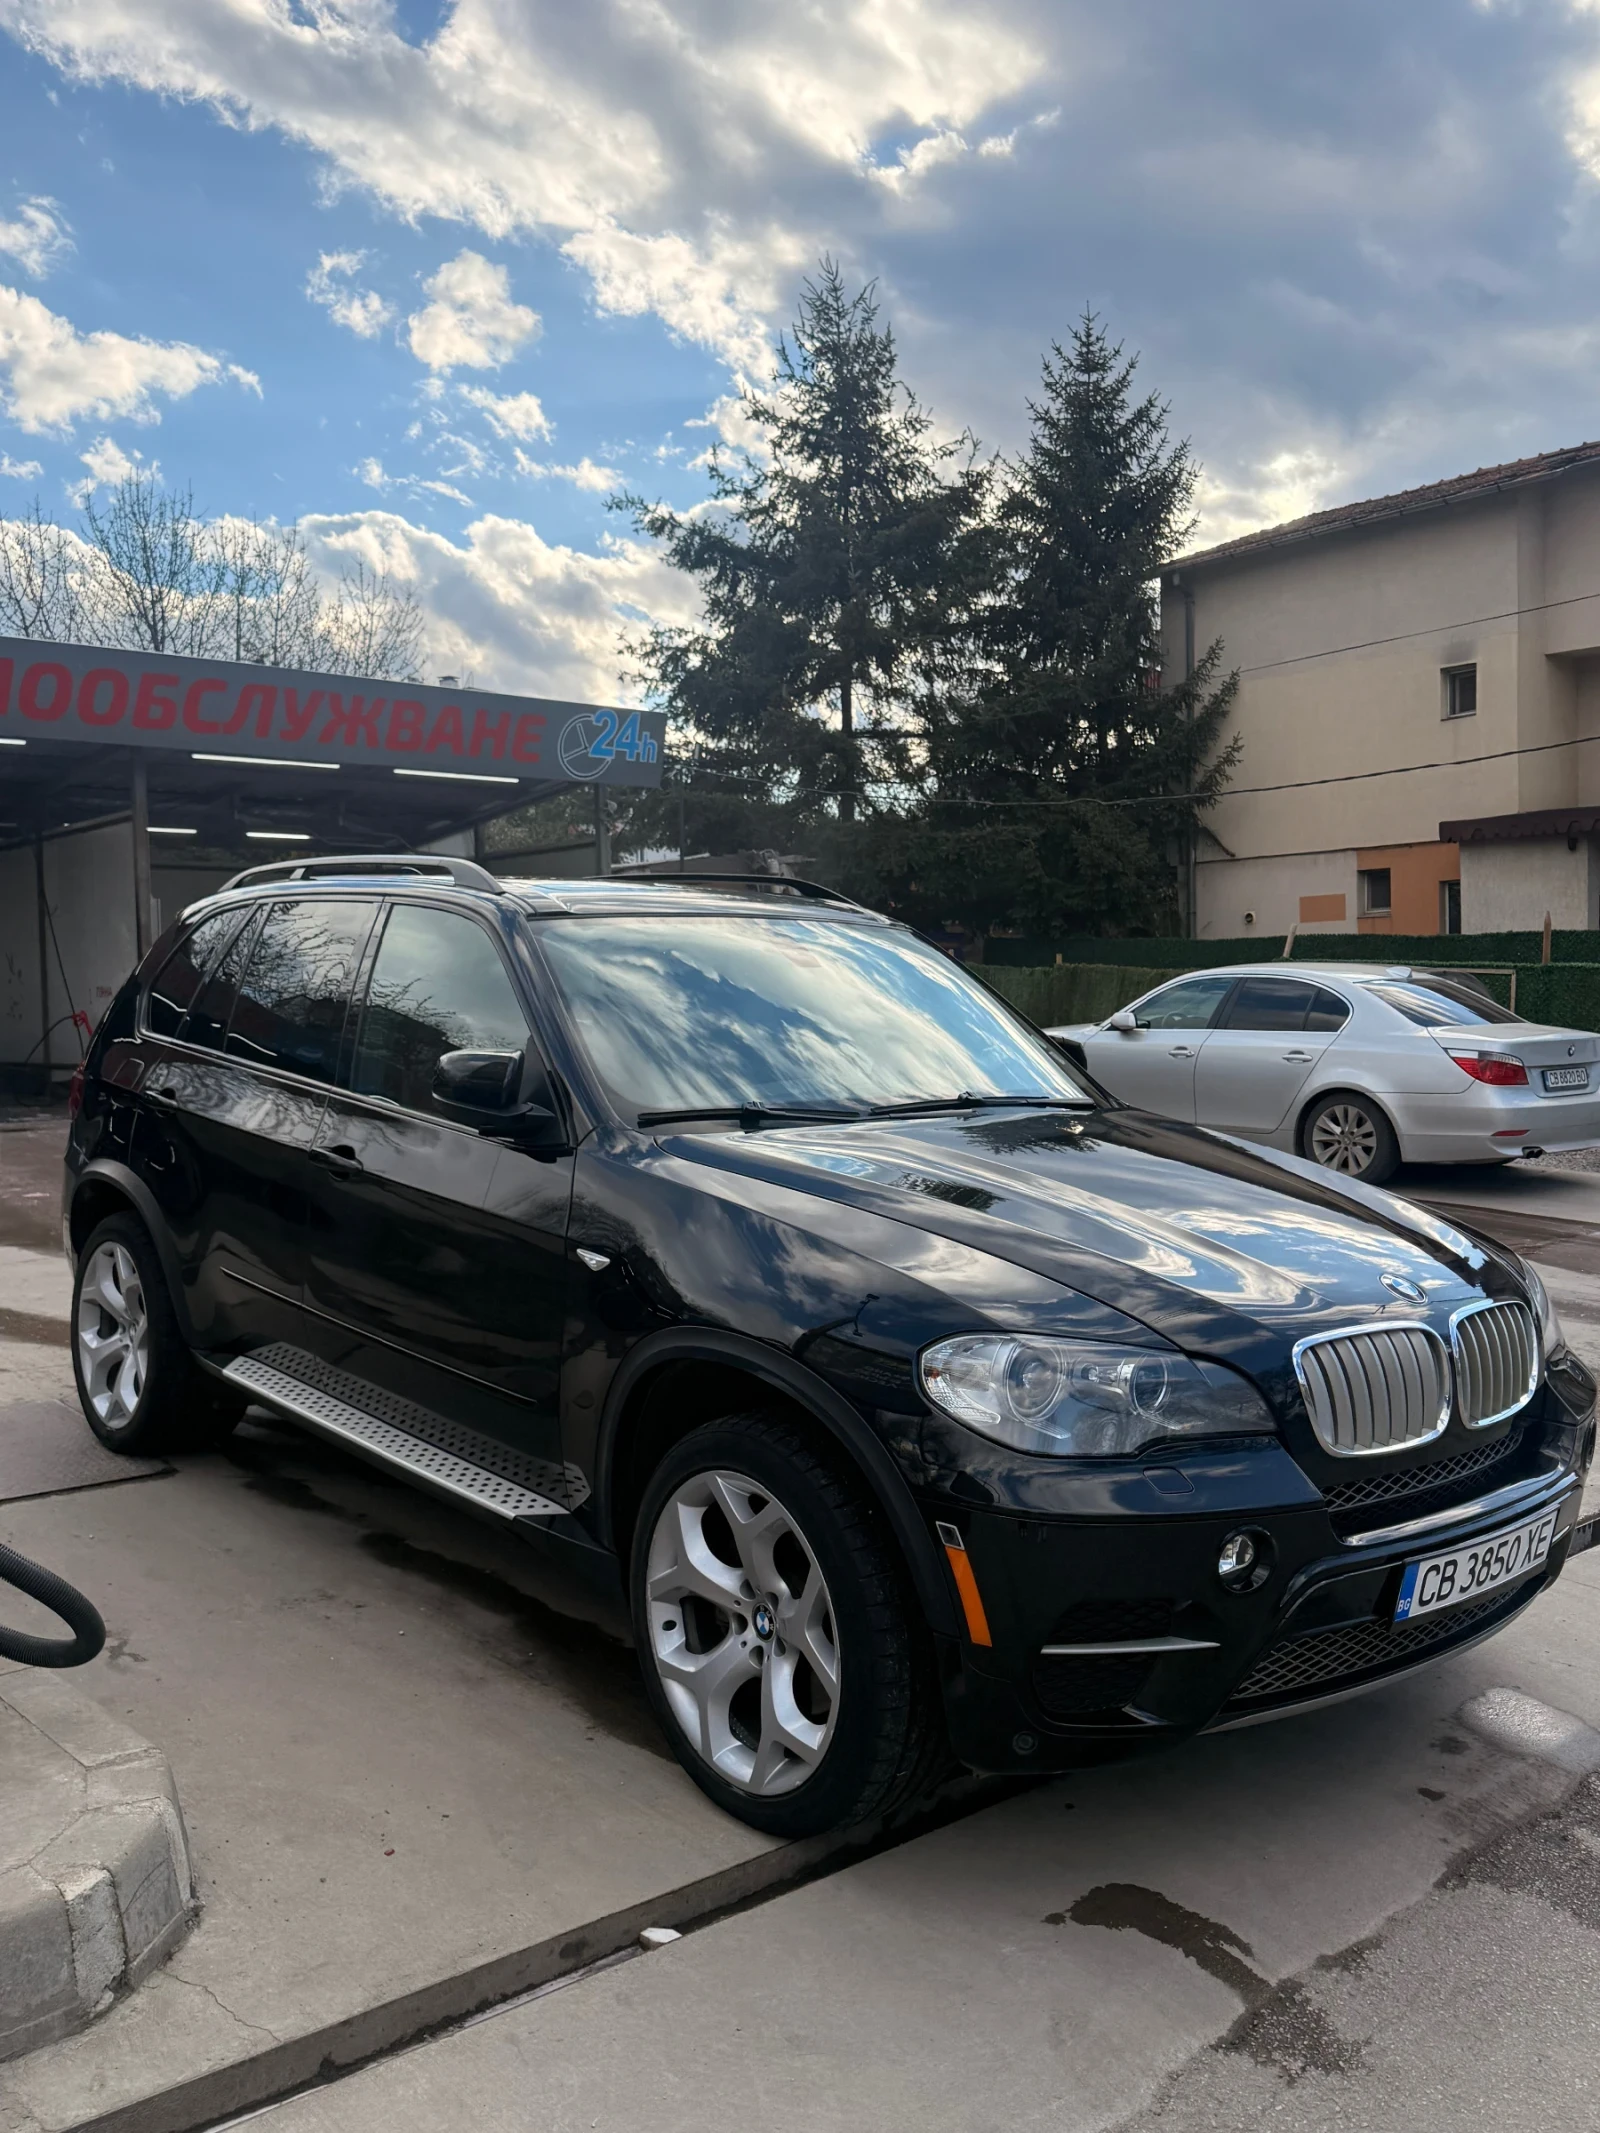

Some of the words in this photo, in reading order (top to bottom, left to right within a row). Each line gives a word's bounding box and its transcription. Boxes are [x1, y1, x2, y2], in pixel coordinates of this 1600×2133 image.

[0, 657, 547, 763] ООБСЛУЖВАНЕ
[588, 708, 658, 763] 24h
[1549, 1071, 1559, 1086] CB
[1418, 1558, 1458, 1607] CB
[1459, 1534, 1522, 1594] 3850
[1520, 1518, 1553, 1569] XE
[1397, 1598, 1411, 1613] BG
